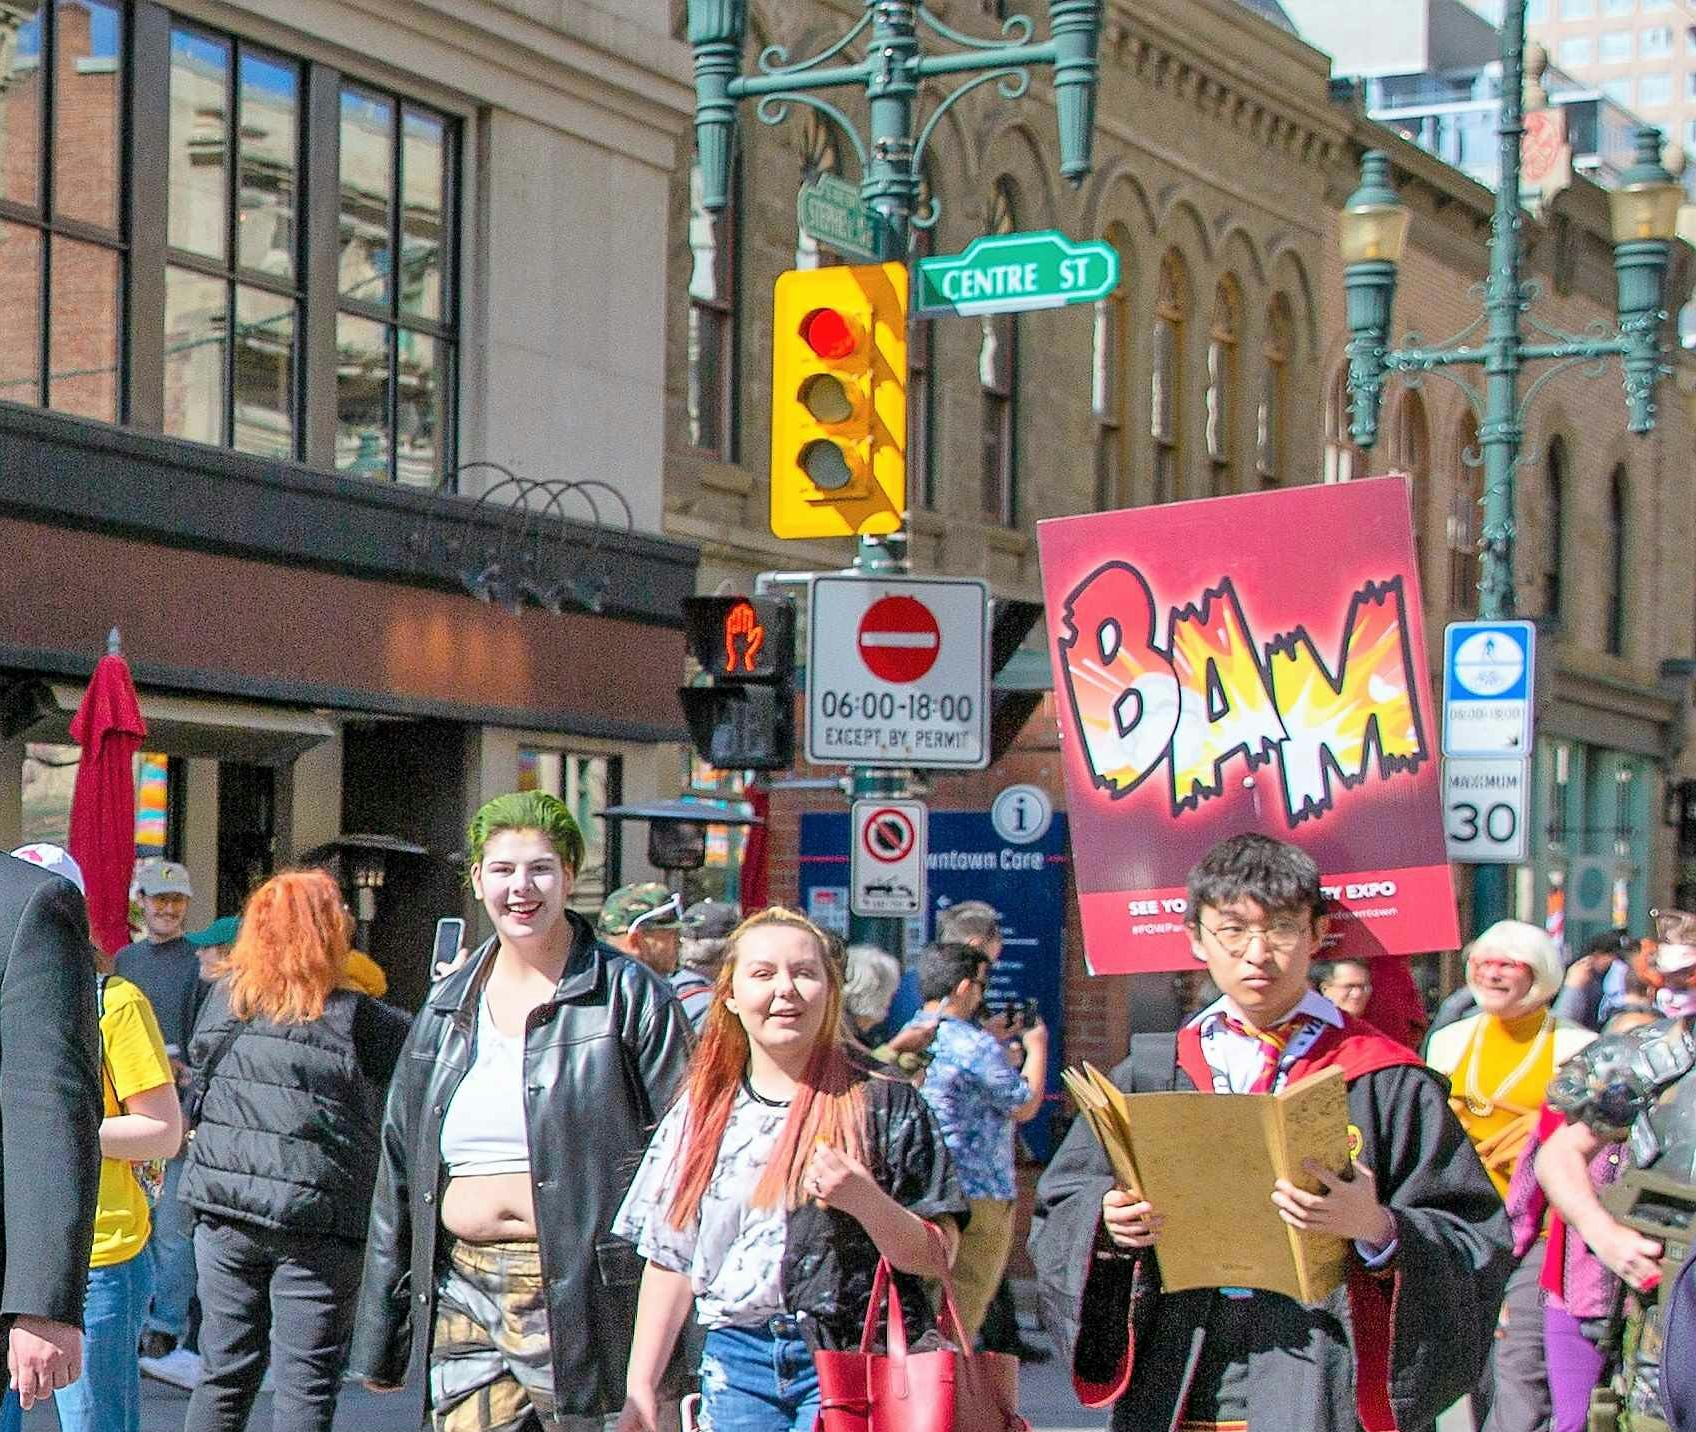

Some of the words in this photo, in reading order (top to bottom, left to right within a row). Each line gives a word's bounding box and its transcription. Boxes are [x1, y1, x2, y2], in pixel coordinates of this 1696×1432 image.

[942, 262, 1038, 301] CENTRE
[1058, 257, 1090, 290] ST
[1059, 560, 1429, 829] BAM
[822, 690, 972, 723] 06:00-18:00
[825, 727, 882, 748] EXCEPT
[888, 729, 907, 748] BY
[915, 730, 969, 749] PERMIT
[1448, 773, 1519, 791] MAXIMUM
[1449, 802, 1517, 843] 30
[924, 852, 997, 871] wntown
[999, 848, 1044, 871] Core
[1345, 880, 1397, 900] EXPO
[1128, 900, 1159, 917] SEE
[1160, 897, 1188, 914] YO
